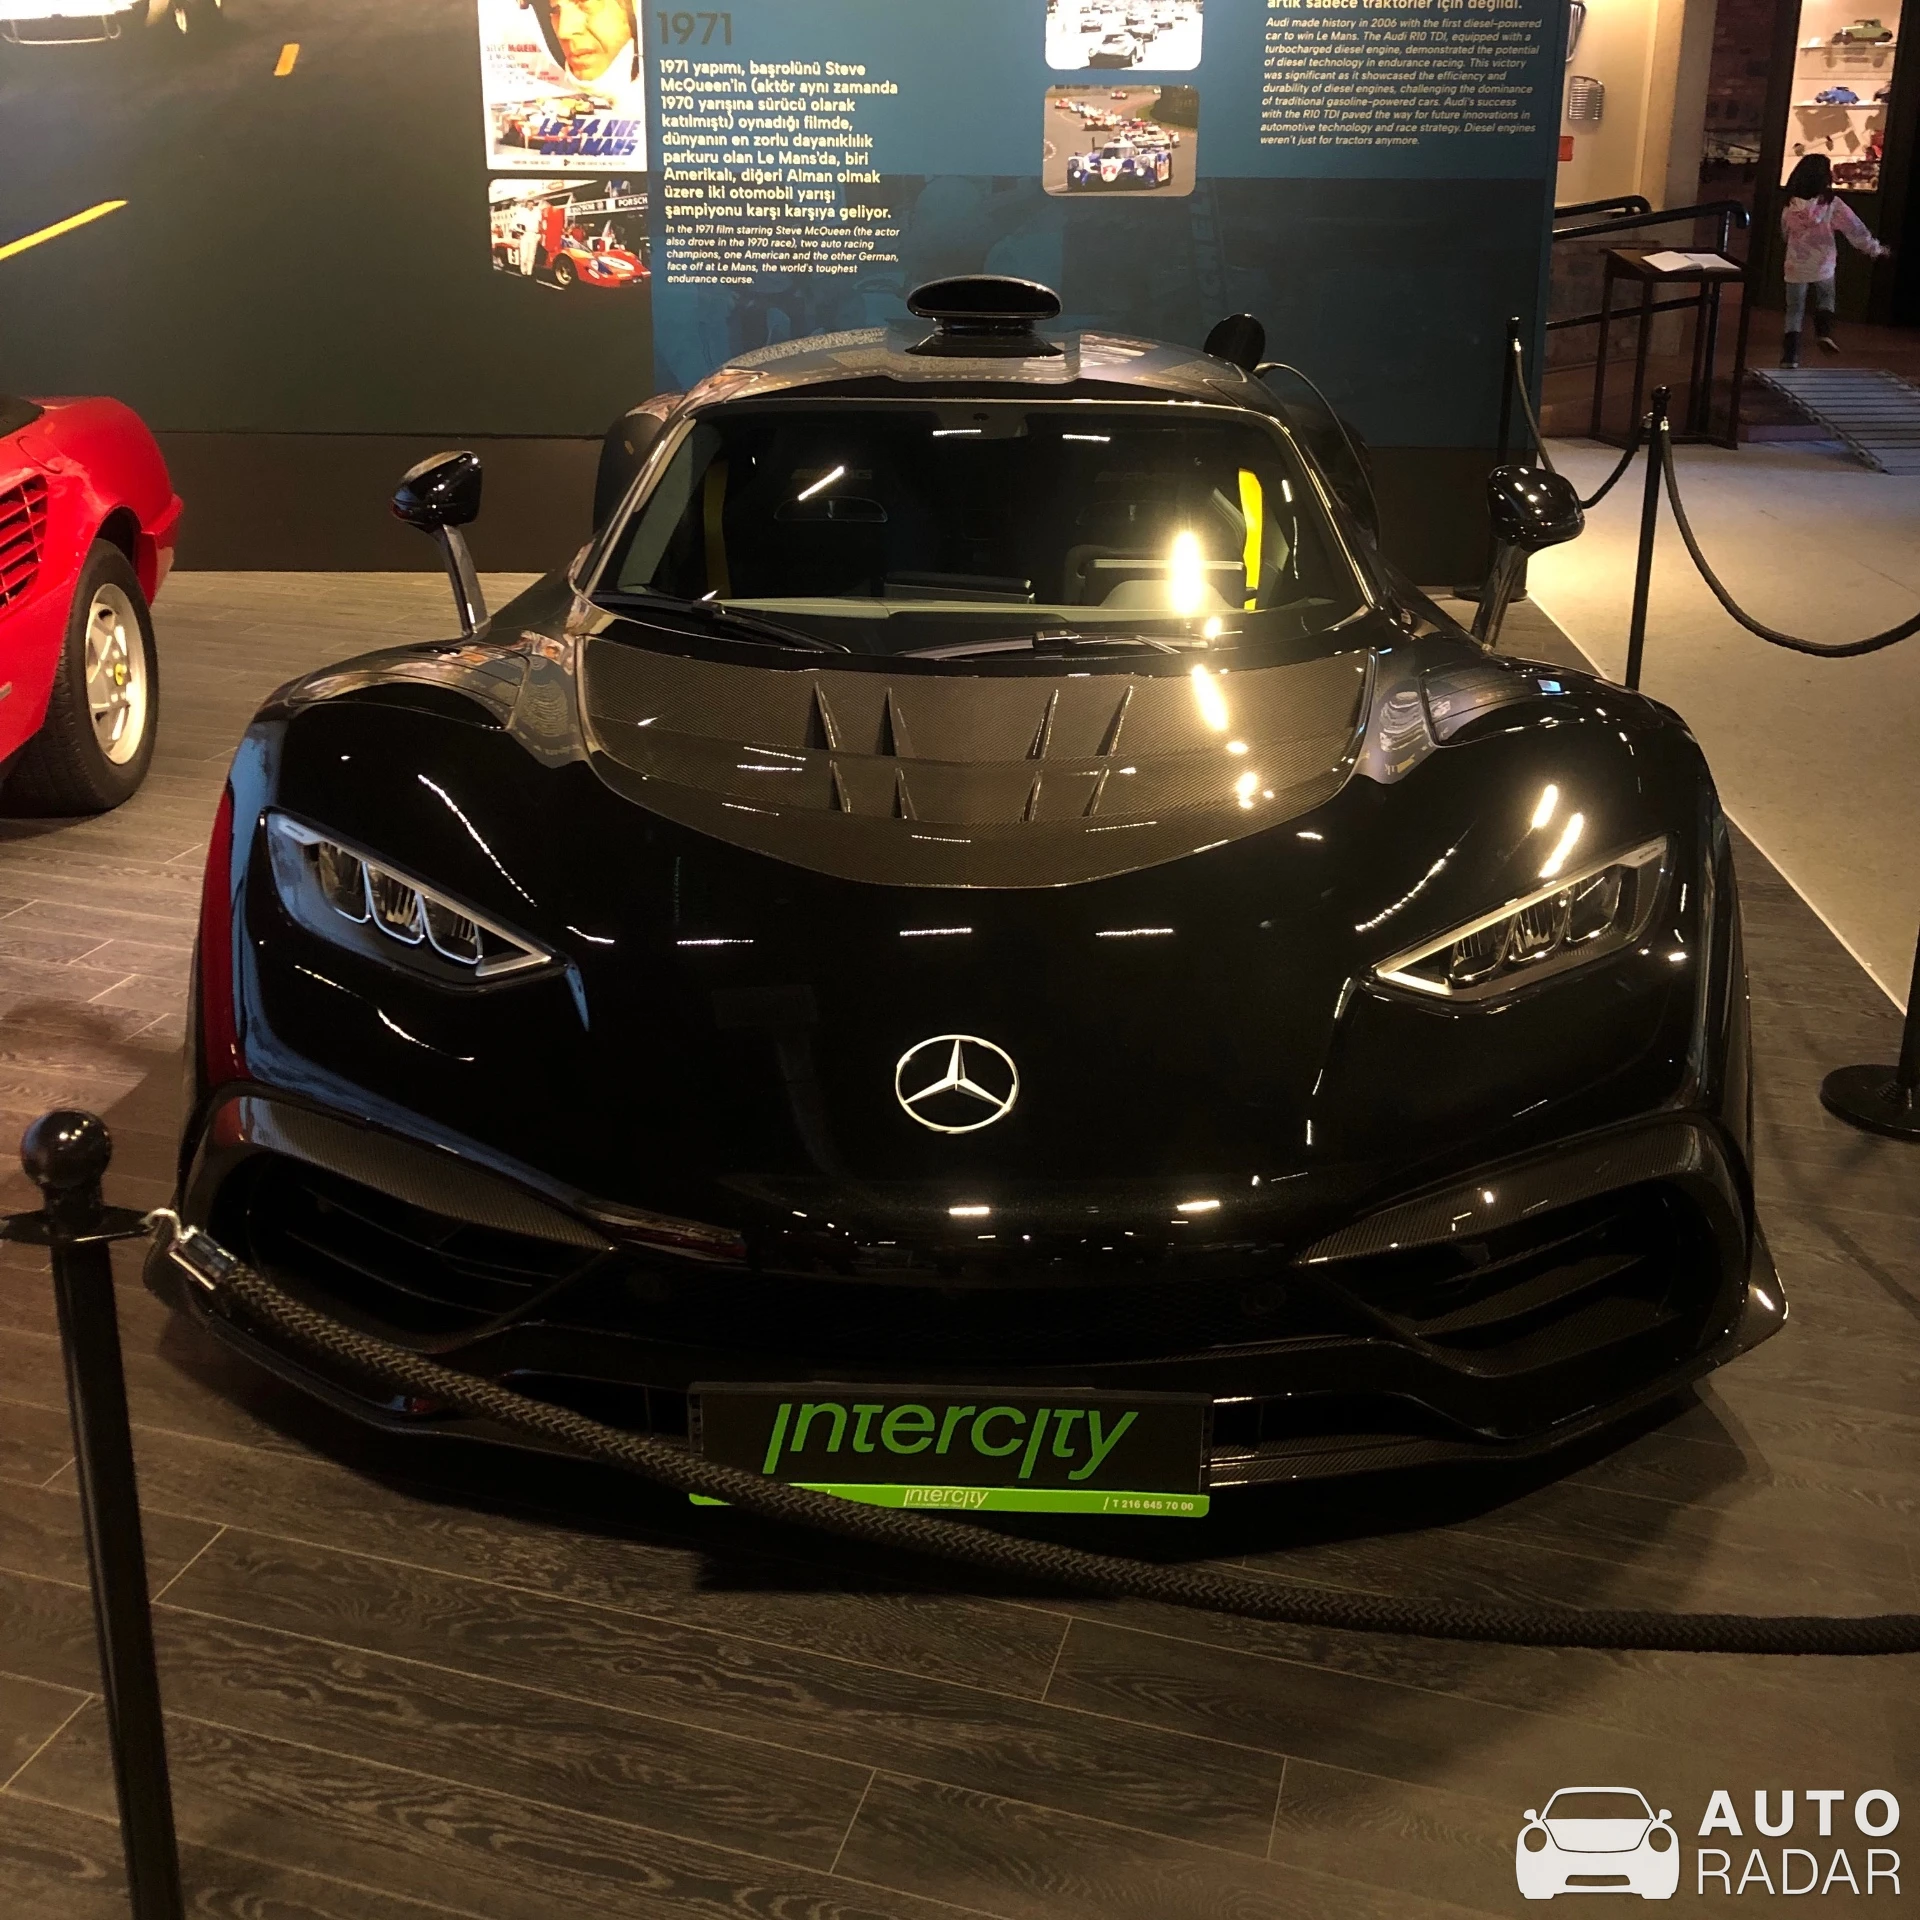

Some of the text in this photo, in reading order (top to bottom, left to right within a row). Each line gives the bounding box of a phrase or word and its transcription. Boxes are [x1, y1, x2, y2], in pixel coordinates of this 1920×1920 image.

[657, 11, 732, 45] 1971
[1265, 17, 1542, 29] Audi made history in 2006 with the first diesel-powered
[1265, 32, 1282, 40] car
[1297, 31, 1314, 40] win
[1316, 31, 1329, 41] Le
[1330, 31, 1360, 41] Mans.
[1363, 31, 1382, 41] The
[1383, 31, 1407, 41] Audi
[1451, 32, 1500, 42] equipped
[1502, 32, 1523, 41] with
[1265, 44, 1540, 56] turbocharged diesel engine, demonstrated the potential
[660, 59, 866, 78] 1971 yapımı, başrolünü Steve
[1276, 57, 1527, 69] diesel technology endurance racing. This victory
[1264, 70, 1507, 82] was significant showcased the efficiency and
[660, 77, 898, 96] McQueen'in (aktör aynı zamanda
[1262, 83, 1533, 95] durability diesel engines, challenging the dominance
[661, 96, 855, 114] 1970 yarışına sürücü olarak
[1275, 96, 1517, 107] traditional gasoline-powered cars. Audi's success
[1261, 109, 1282, 119] with
[1284, 109, 1300, 119] the
[1323, 109, 1340, 119] TDI
[1341, 109, 1373, 120] paved
[1374, 110, 1391, 119] the
[1393, 111, 1413, 121] way
[1414, 110, 1429, 119] for
[1431, 110, 1460, 120] future
[1462, 110, 1519, 120] innovations
[662, 113, 853, 132] katılmıştı) oynadığı filmde,
[1260, 122, 1536, 134] automotive technology and race strategy. Diesel engines
[662, 131, 873, 150] dünyanın en zorlu dayanıklılık
[1260, 134, 1420, 146] weren't just for tractors anymore.
[663, 149, 869, 167] parkuru olan Le Mans'da, biri
[664, 167, 880, 184] Amerikalı, diğeri Alman olmak
[664, 185, 835, 204] üzere iki otomobil yarışı
[665, 202, 892, 221] şampiyonu karşı karşıya geliyor.
[665, 224, 900, 237] In the 1971 film starring Steve McQueen (the actor
[665, 236, 874, 250] also drove in the 1970 race), two auto racing
[666, 249, 721, 260] champions,
[744, 250, 790, 260] American
[792, 251, 811, 260] and
[813, 251, 829, 260] the
[830, 251, 856, 260] other
[858, 251, 899, 262] German,
[667, 261, 858, 275] face off at Le Mans, the world's toughest
[667, 274, 755, 284] endurance course.
[1112, 1499, 1194, 1511] T 216 645 70 00
